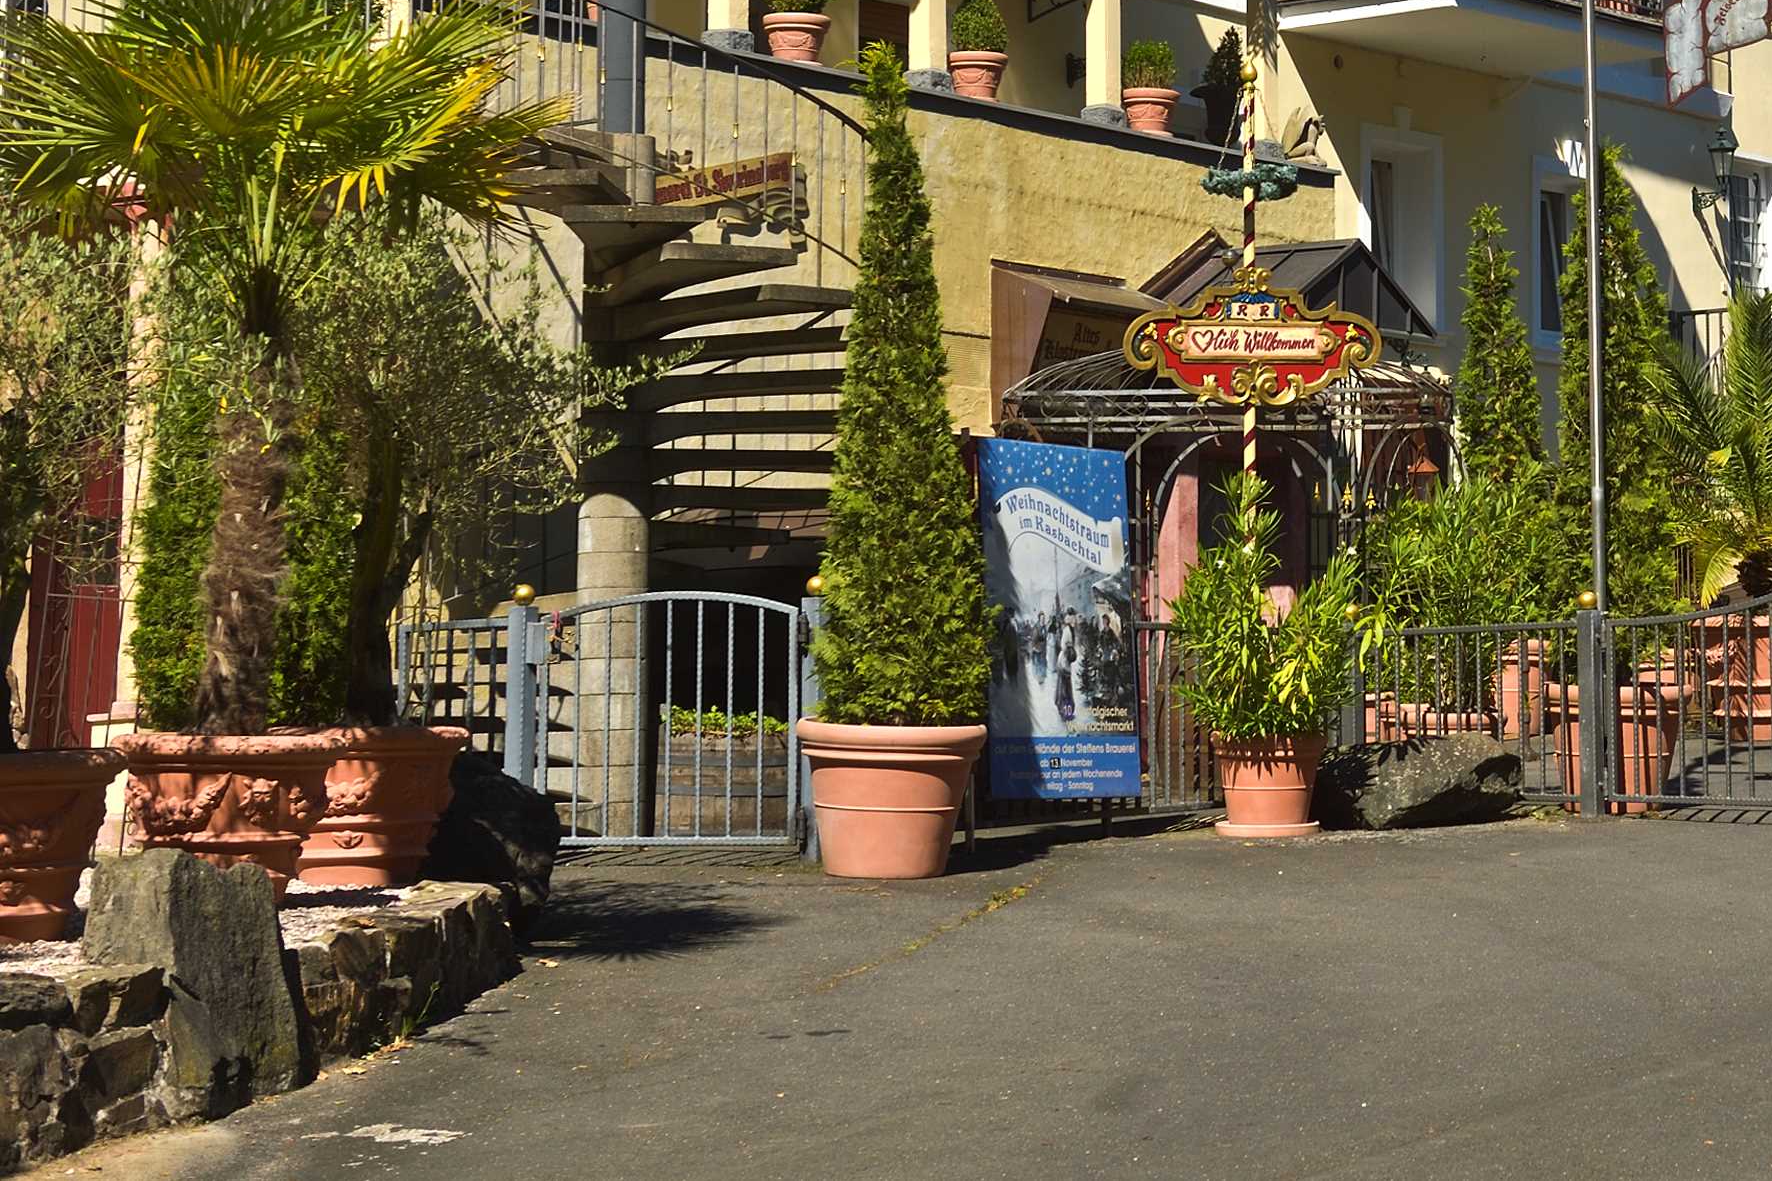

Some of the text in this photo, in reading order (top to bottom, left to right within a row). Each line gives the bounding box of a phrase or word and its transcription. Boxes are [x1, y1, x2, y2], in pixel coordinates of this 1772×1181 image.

[1244, 329, 1315, 354] Willkommen
[1005, 493, 1110, 548] Weihnachtstraum
[1020, 516, 1102, 565] im Kasbachtal
[1062, 744, 1075, 754] der
[1105, 743, 1136, 753] Brauerei
[1040, 759, 1049, 768] ab
